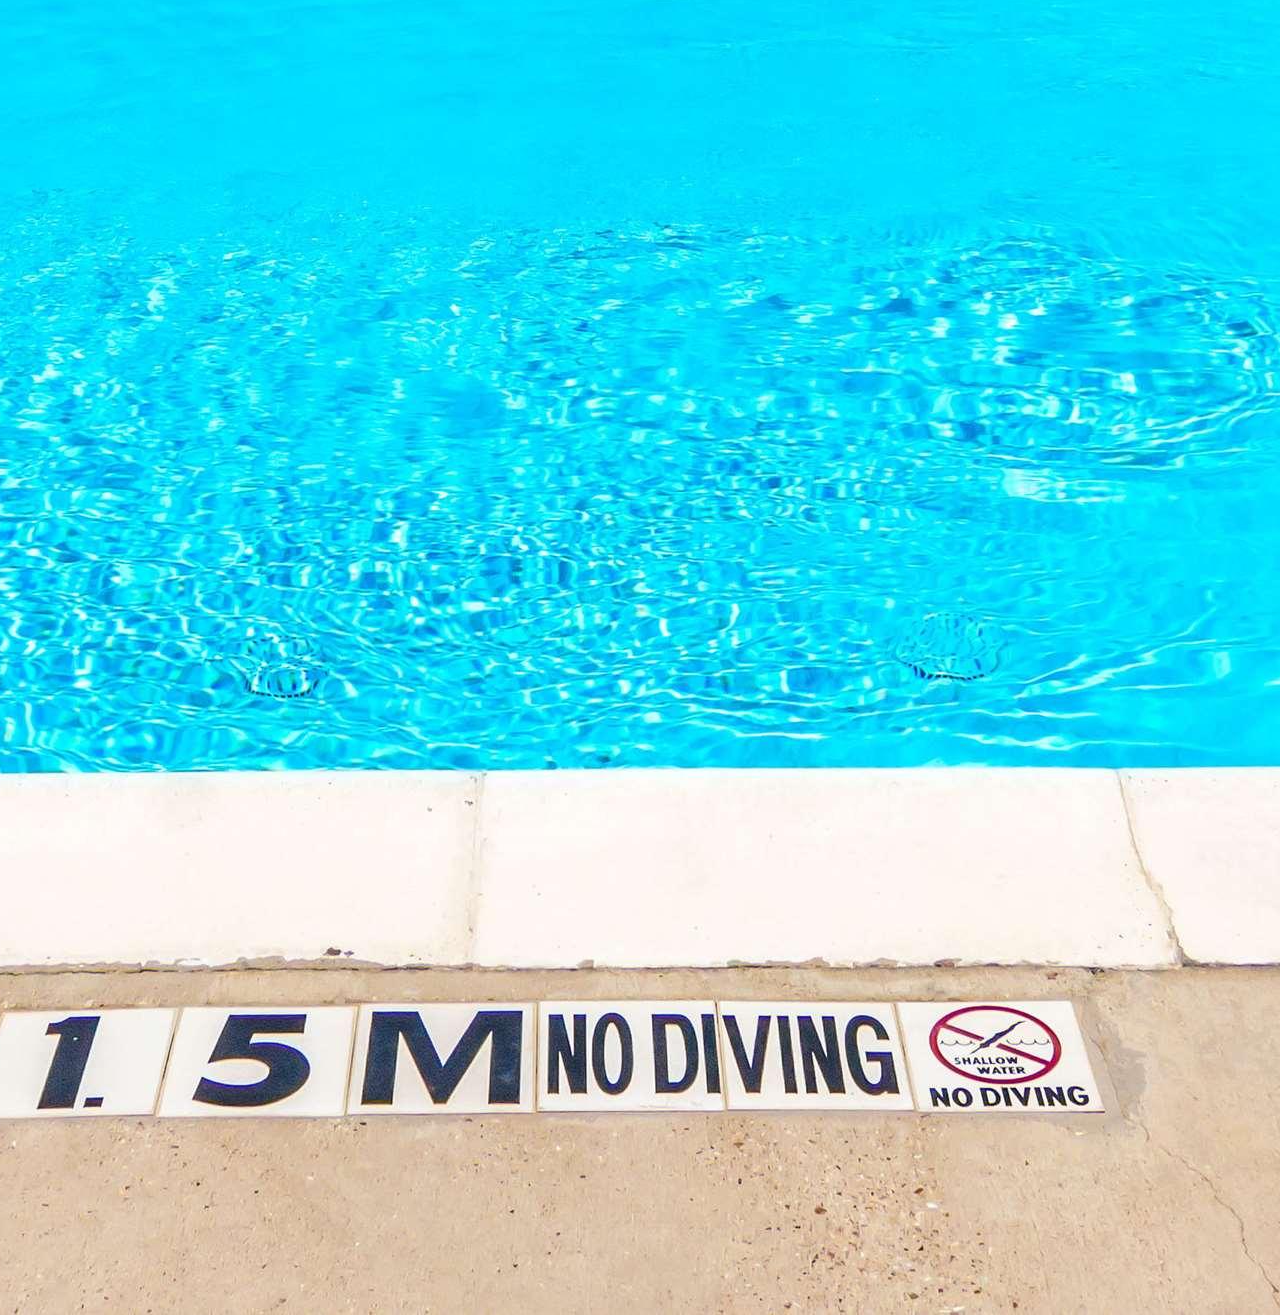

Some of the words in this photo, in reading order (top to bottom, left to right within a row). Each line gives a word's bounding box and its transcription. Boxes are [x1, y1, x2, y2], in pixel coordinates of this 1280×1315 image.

[360, 1010, 523, 1105] M
[548, 1012, 634, 1094] NO
[654, 1012, 901, 1095] DIVING
[954, 1056, 1018, 1065] SHALLOW
[977, 1066, 1026, 1075] WATER
[929, 1087, 973, 1107] NO
[979, 1086, 1090, 1107] DIVING
